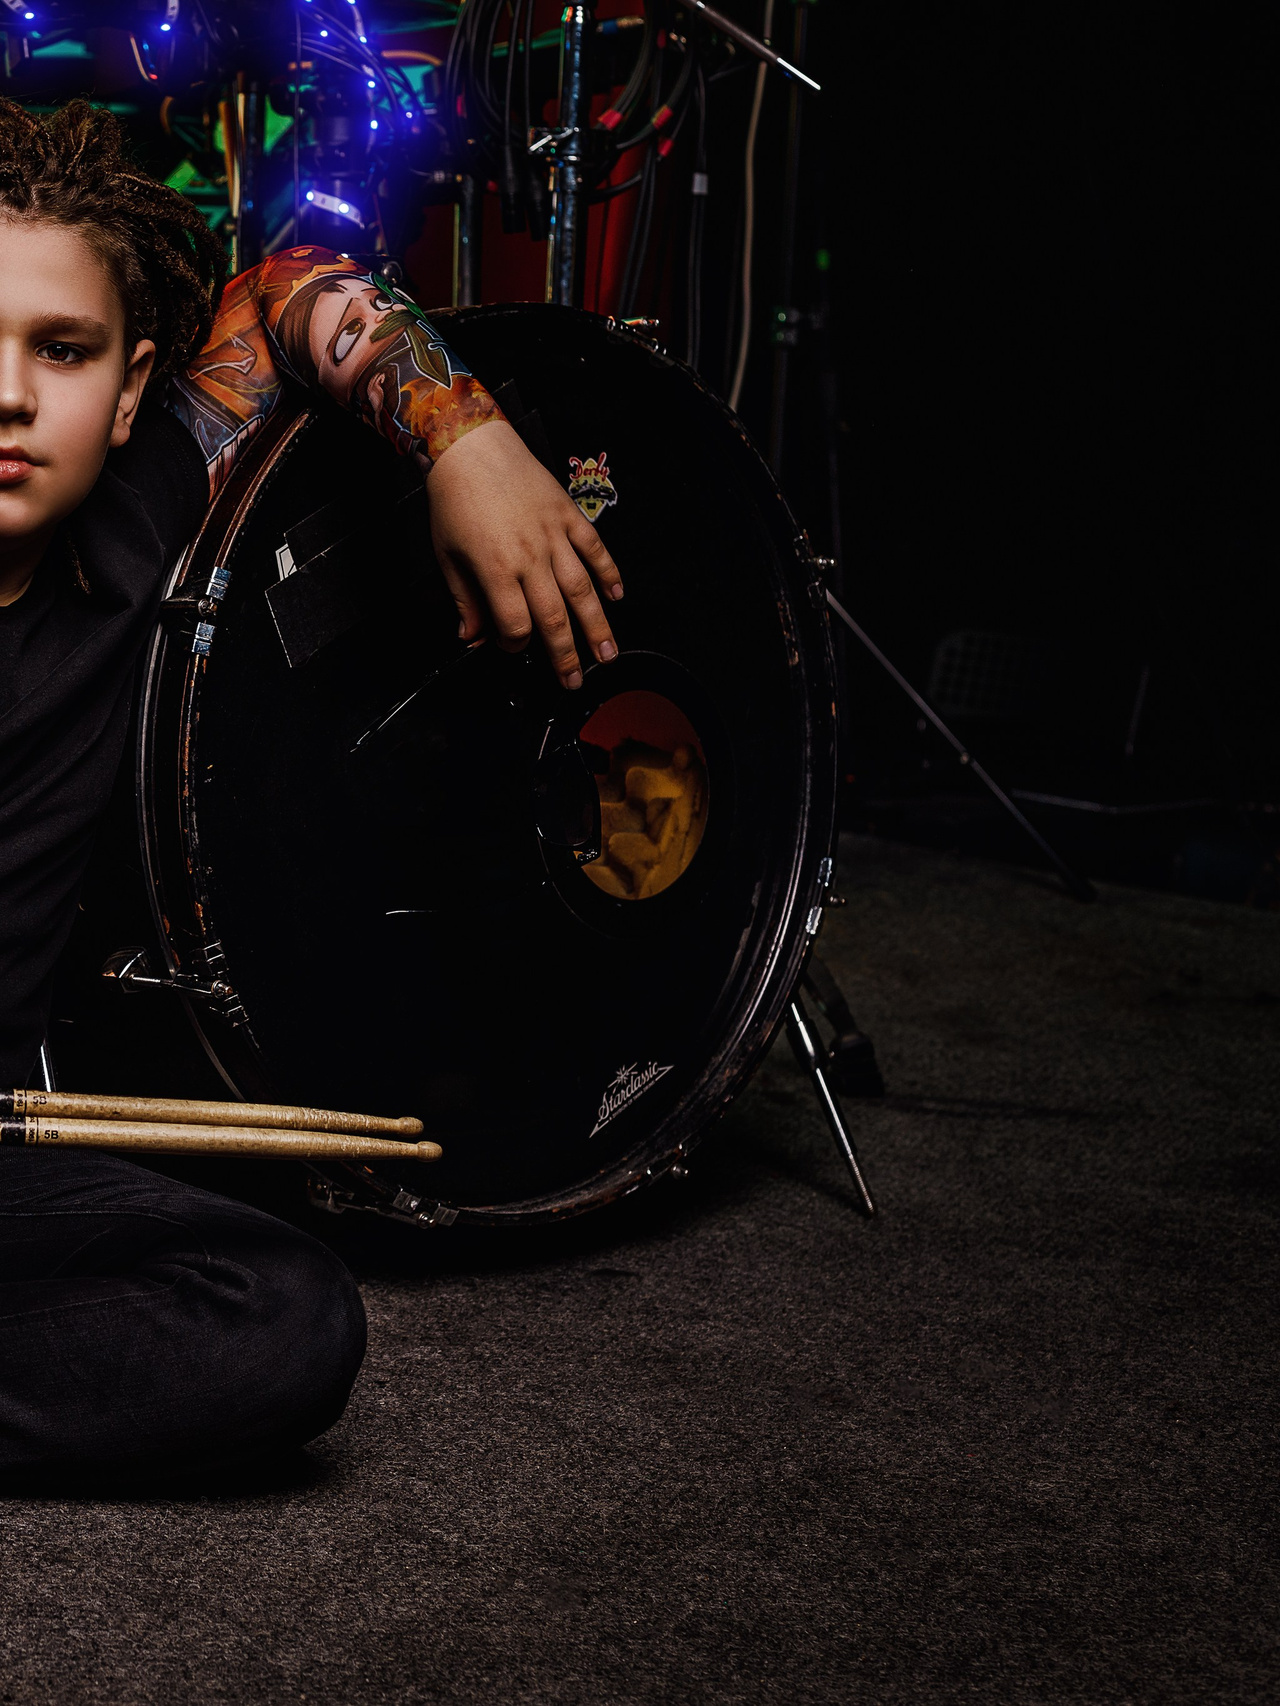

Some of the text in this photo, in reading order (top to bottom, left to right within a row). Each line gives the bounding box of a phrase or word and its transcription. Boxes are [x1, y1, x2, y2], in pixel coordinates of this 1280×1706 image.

[569, 452, 610, 482] Derby
[32, 1095, 48, 1105] 5B
[597, 1060, 661, 1122] Starclassic
[44, 1130, 59, 1140] 5B
